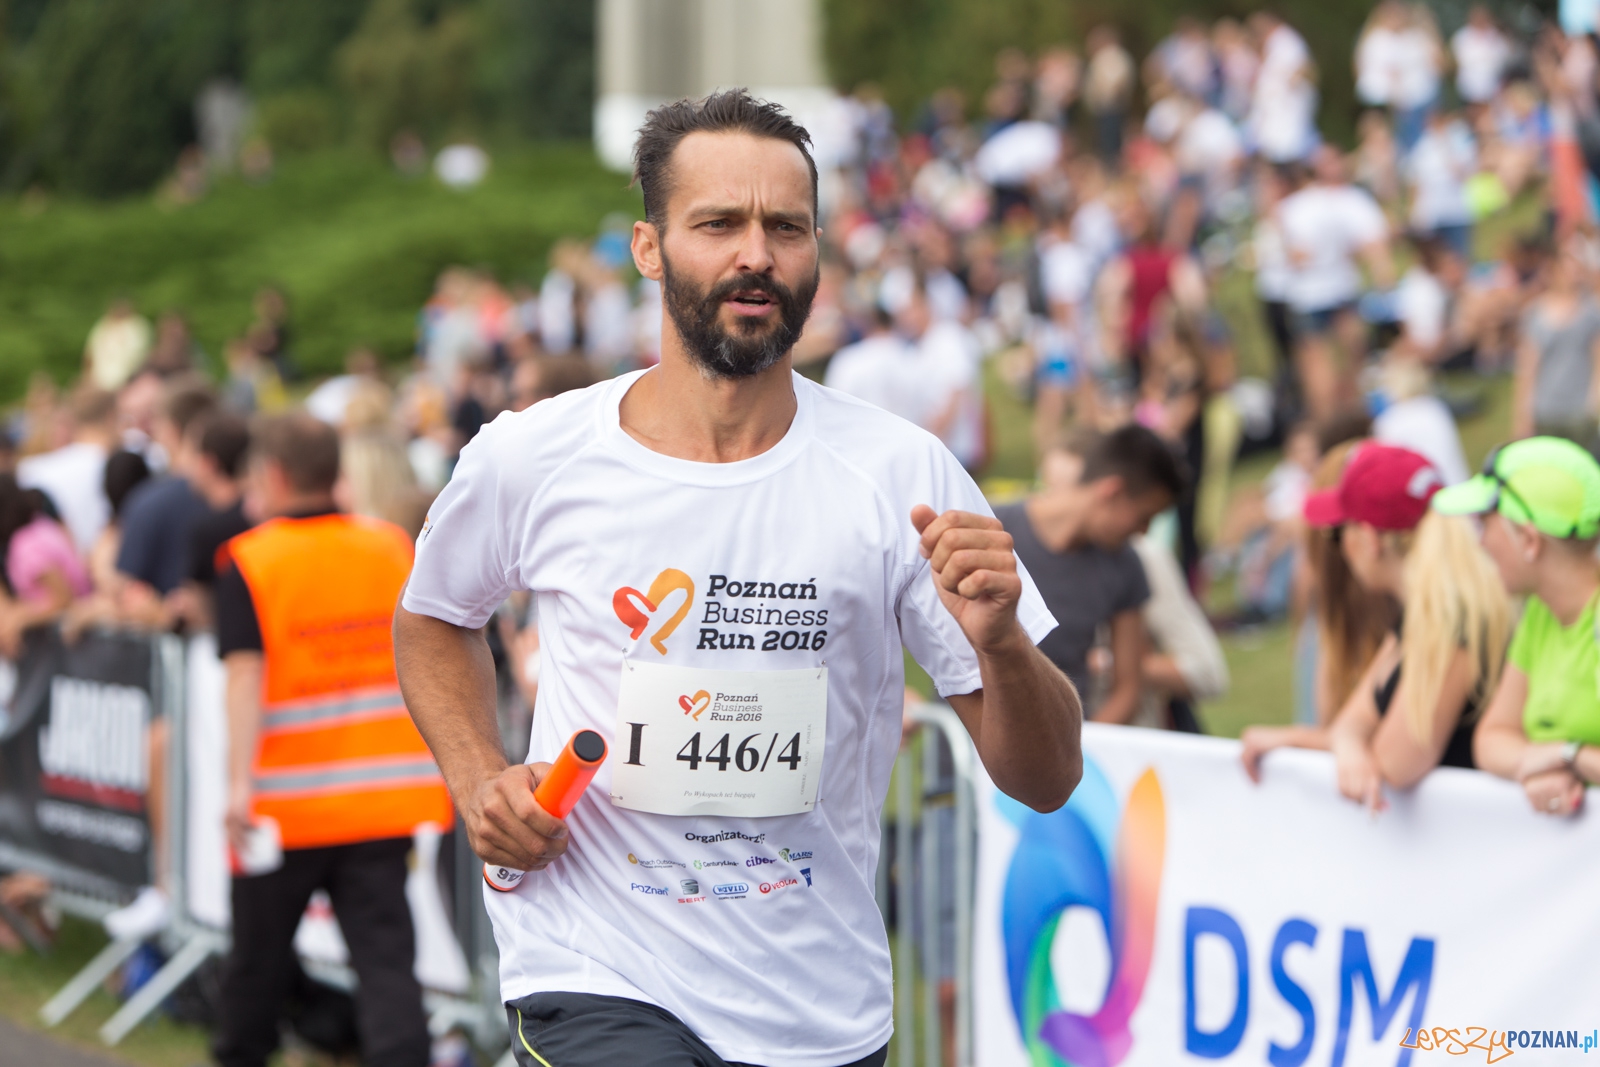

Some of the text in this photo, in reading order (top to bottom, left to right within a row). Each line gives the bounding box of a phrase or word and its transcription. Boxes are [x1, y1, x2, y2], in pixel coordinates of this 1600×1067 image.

[706, 575, 818, 600] Poznań
[701, 601, 829, 626] Business
[696, 628, 828, 651] Run 2016
[715, 692, 759, 702] Poznań
[712, 702, 763, 712] Business
[710, 712, 762, 722] Run 2016
[622, 721, 802, 772] I 446/4
[683, 790, 693, 798] Po
[746, 856, 777, 868] ciber
[772, 878, 798, 890] VEOLIA
[1184, 906, 1436, 1067] DSM
